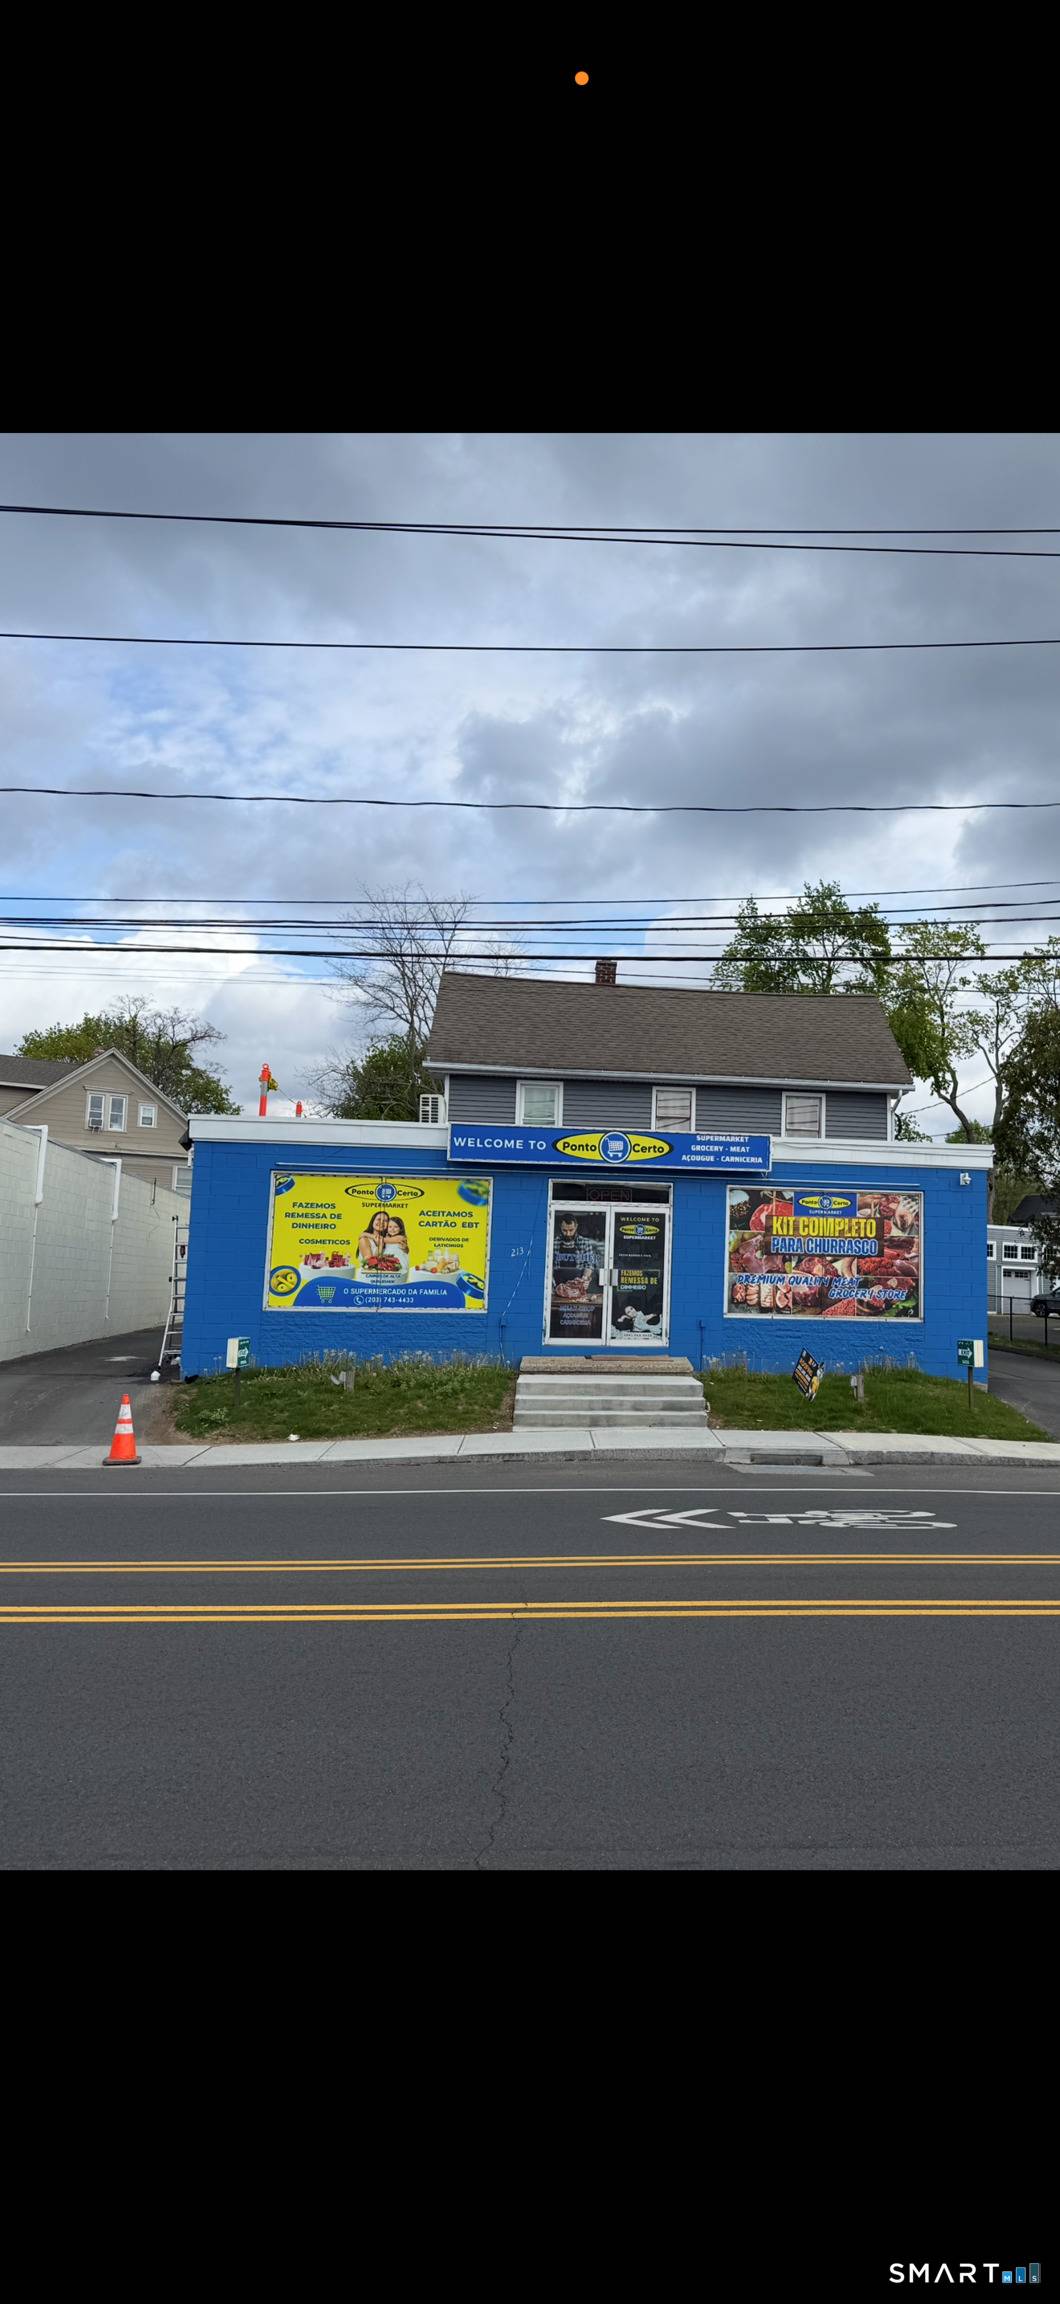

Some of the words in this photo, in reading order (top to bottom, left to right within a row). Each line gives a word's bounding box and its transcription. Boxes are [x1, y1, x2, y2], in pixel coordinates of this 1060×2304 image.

[696, 1134, 749, 1143] SUPERMARKET
[453, 1137, 524, 1149] WELCOME
[528, 1140, 547, 1150] TO
[562, 1141, 597, 1152] Ponto
[632, 1143, 665, 1154] Certo
[682, 1154, 715, 1163] AÇOUGUE
[721, 1155, 763, 1164] CARNICERIA
[397, 1189, 419, 1197] Certo
[589, 1188, 630, 1201] OPEN
[292, 1201, 336, 1209] FAZEMOS
[284, 1212, 328, 1220] REMESSA
[418, 1210, 474, 1218] ACEITAMOS
[291, 1222, 337, 1230] DINHEIRO
[418, 1219, 457, 1228] CARTÃO
[461, 1221, 480, 1229] EBT
[772, 1216, 794, 1236] KIT
[799, 1216, 877, 1238] COMPLETO
[298, 1238, 351, 1246] COSMETICOS
[771, 1237, 803, 1254] PARA
[806, 1238, 878, 1256] CHURRASCO
[511, 1246, 524, 1257] 213
[737, 1273, 786, 1285] PREMIUM
[788, 1275, 831, 1287] QUALITY
[832, 1276, 862, 1288] MEAT
[350, 1288, 406, 1296] SUPERMERCADO
[407, 1288, 418, 1296] DA
[419, 1288, 448, 1296] FAMILIA
[828, 1288, 874, 1300] GROCERY
[876, 1289, 908, 1299] STORE
